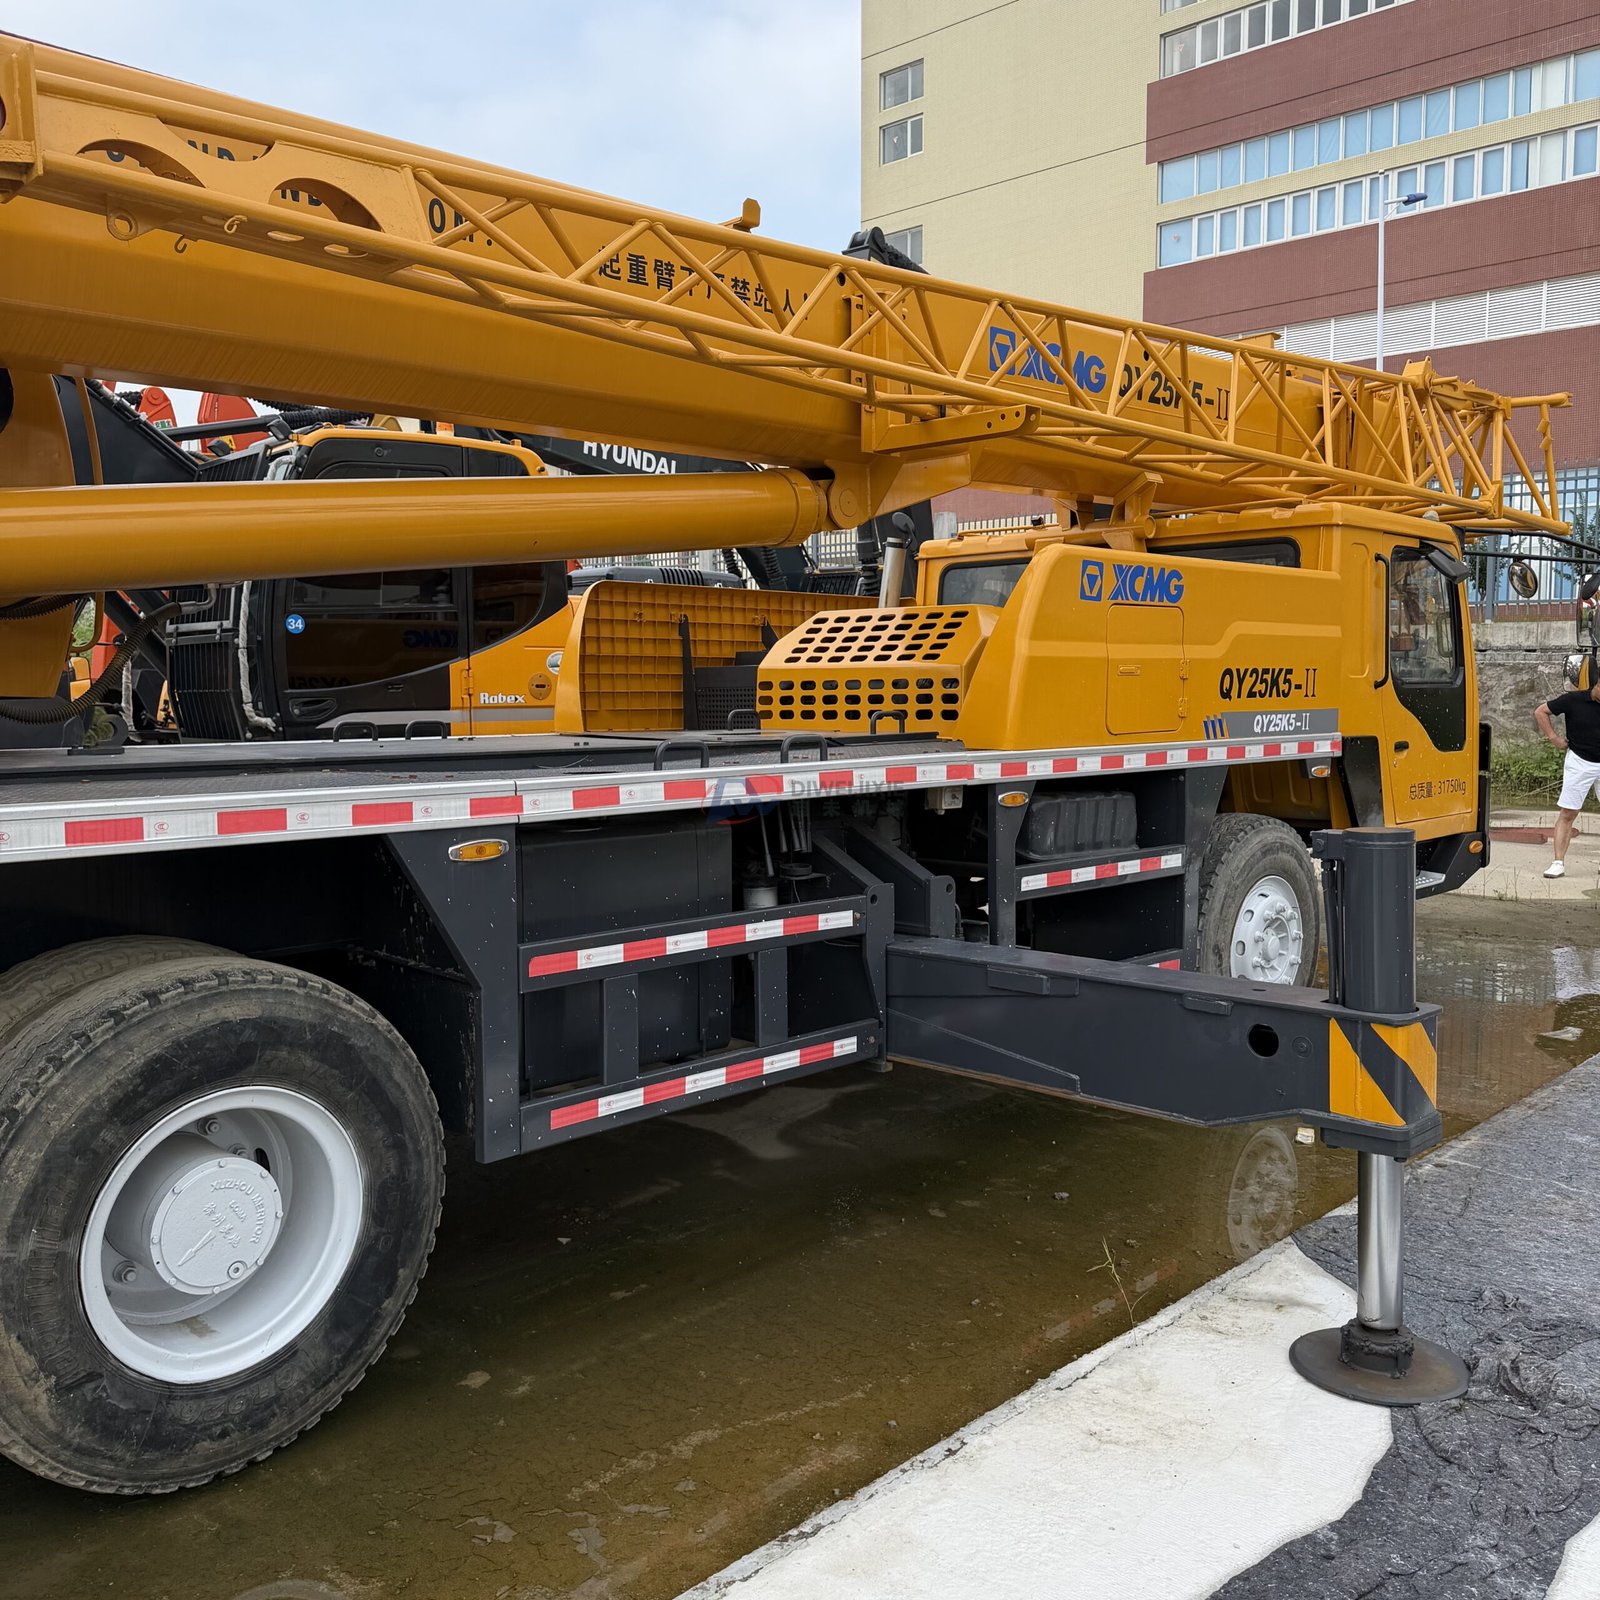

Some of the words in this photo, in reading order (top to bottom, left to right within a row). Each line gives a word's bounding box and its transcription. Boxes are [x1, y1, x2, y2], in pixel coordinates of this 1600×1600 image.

[583, 440, 677, 475] HYUNDAI
[1107, 563, 1184, 604] XCMG
[288, 618, 303, 631] 34
[249, 1192, 266, 1244] MERITOR
